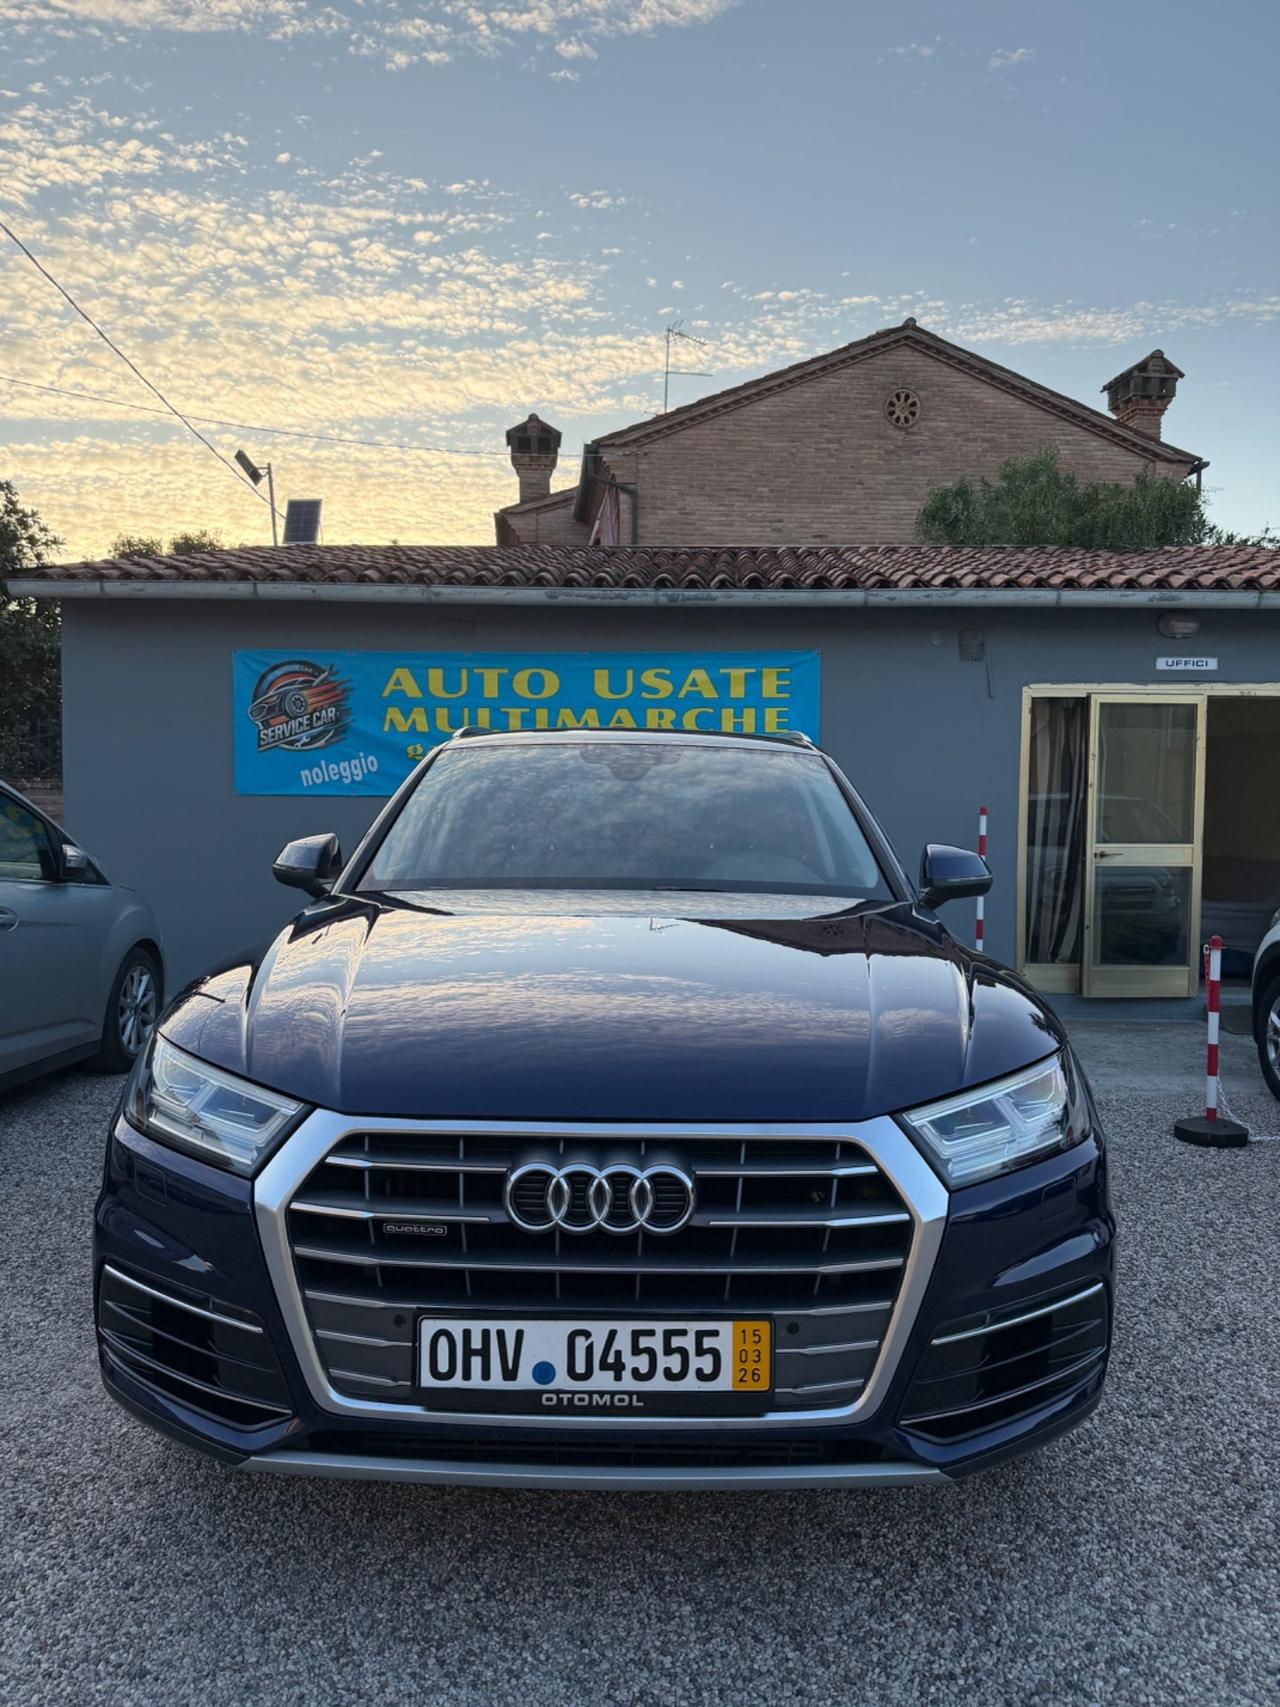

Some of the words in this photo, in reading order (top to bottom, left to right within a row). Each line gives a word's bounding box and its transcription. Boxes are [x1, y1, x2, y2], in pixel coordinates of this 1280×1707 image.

[1165, 659, 1209, 668] UFFICI
[382, 667, 560, 699] AUTO
[593, 667, 791, 699] USATE
[260, 718, 311, 745] SERVICE
[313, 706, 337, 727] CAR
[383, 706, 790, 734] MULTIMARCHE
[300, 752, 378, 787] noleggio
[385, 1224, 445, 1235] quattro
[740, 1328, 762, 1344] 15
[429, 1328, 525, 1381] OHV
[566, 1328, 722, 1382] 04555
[739, 1348, 762, 1363] 03
[738, 1367, 761, 1382] 26
[541, 1393, 644, 1406] OTOMOL
